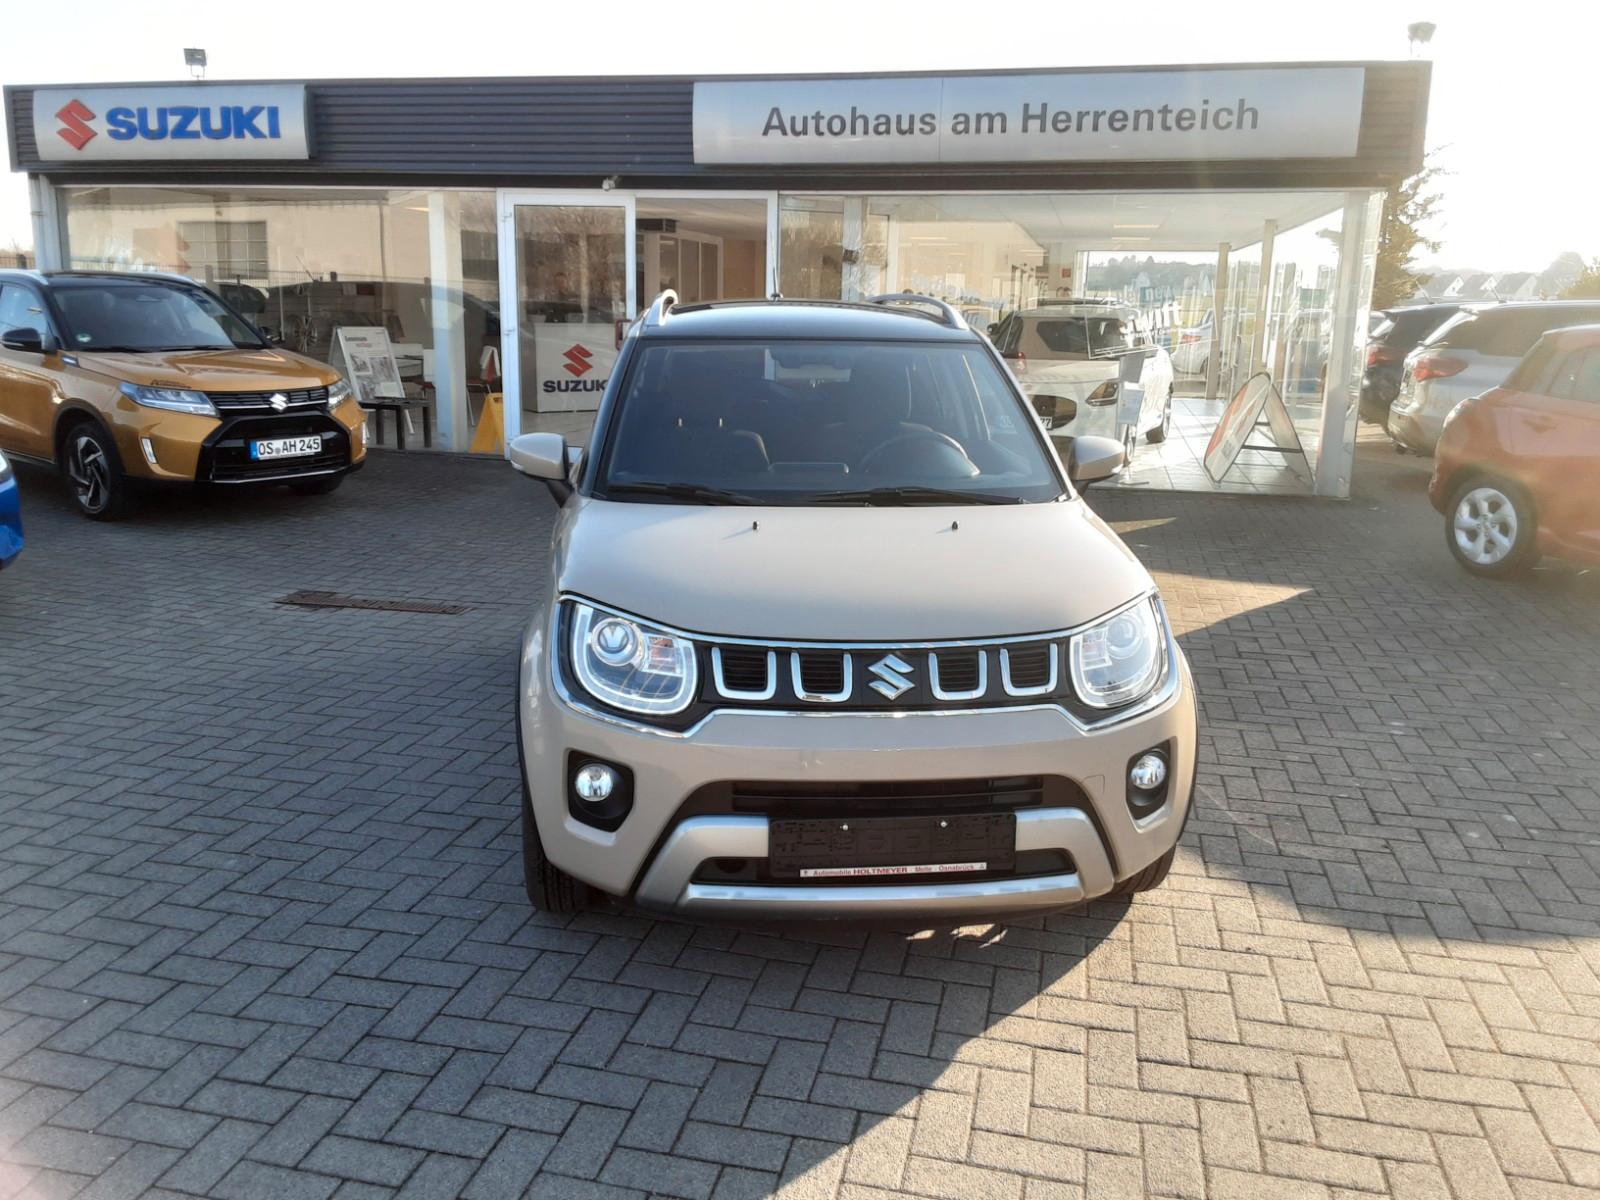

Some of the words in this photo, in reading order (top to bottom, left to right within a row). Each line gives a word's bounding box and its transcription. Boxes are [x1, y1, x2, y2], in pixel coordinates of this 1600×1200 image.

[106, 106, 281, 140] SUZUKI
[762, 106, 936, 137] Autohaus
[951, 111, 1008, 135] am
[1021, 98, 1259, 134] Herrenteich
[543, 379, 608, 393] SUZUK
[258, 442, 274, 455] OS
[281, 440, 297, 453] AH
[299, 438, 320, 452] 245
[853, 866, 908, 875] HOLTMEYER
